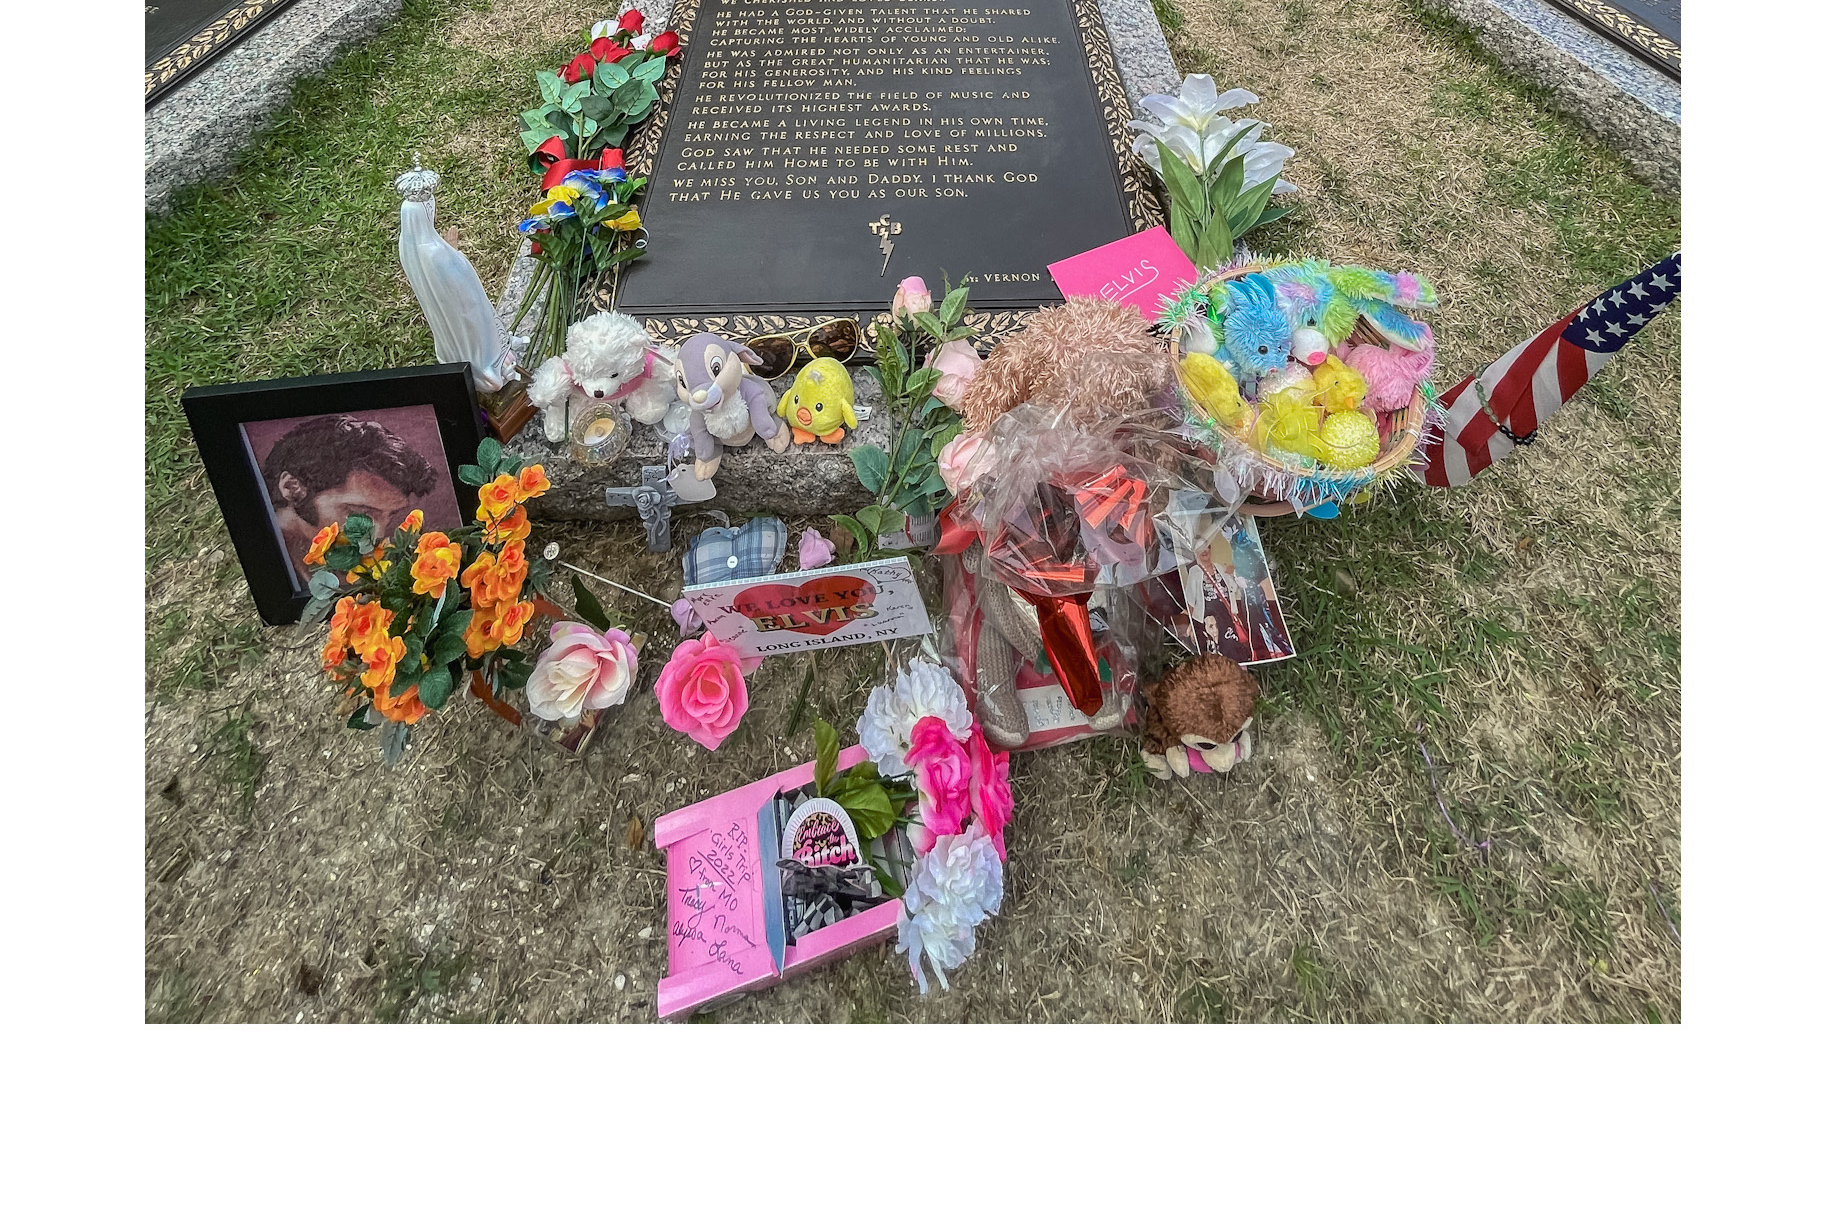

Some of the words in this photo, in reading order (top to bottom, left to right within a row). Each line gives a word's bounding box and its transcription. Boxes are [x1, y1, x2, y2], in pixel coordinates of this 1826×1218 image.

[716, 11, 732, 19] HE
[738, 10, 766, 18] HAD
[771, 9, 779, 17] A
[984, 8, 1031, 16] SHARED
[723, 148, 754, 157] SAW
[761, 147, 802, 156] THAT
[809, 146, 827, 155] HE
[835, 145, 890, 154] NEEDED
[897, 144, 936, 153] SOME
[944, 144, 979, 153] REST
[987, 143, 1018, 153] AND
[677, 161, 736, 171] CALLED
[745, 160, 774, 169] HIM
[836, 159, 856, 168] TO
[864, 159, 880, 167] BE
[888, 158, 928, 167] WITH
[673, 179, 694, 188] WE
[700, 177, 736, 187] MISS
[826, 176, 858, 185] AND
[932, 175, 936, 183] I
[944, 174, 996, 183] THANK
[669, 192, 711, 202] THAT
[751, 191, 793, 200] GAVE
[802, 190, 820, 199] US
[829, 190, 860, 199] YOU
[868, 189, 886, 199] AS
[895, 188, 929, 198] OUR
[935, 188, 968, 198] SON.
[984, 273, 1041, 282] VERNON
[1099, 259, 1160, 300] ELVIS
[717, 602, 758, 615] WE
[767, 592, 829, 610] LOVE
[749, 603, 879, 633] ELVIS
[756, 641, 802, 653] LONG
[804, 631, 872, 646] ISLAND,
[875, 627, 899, 637] NY
[706, 849, 735, 885] 2022
